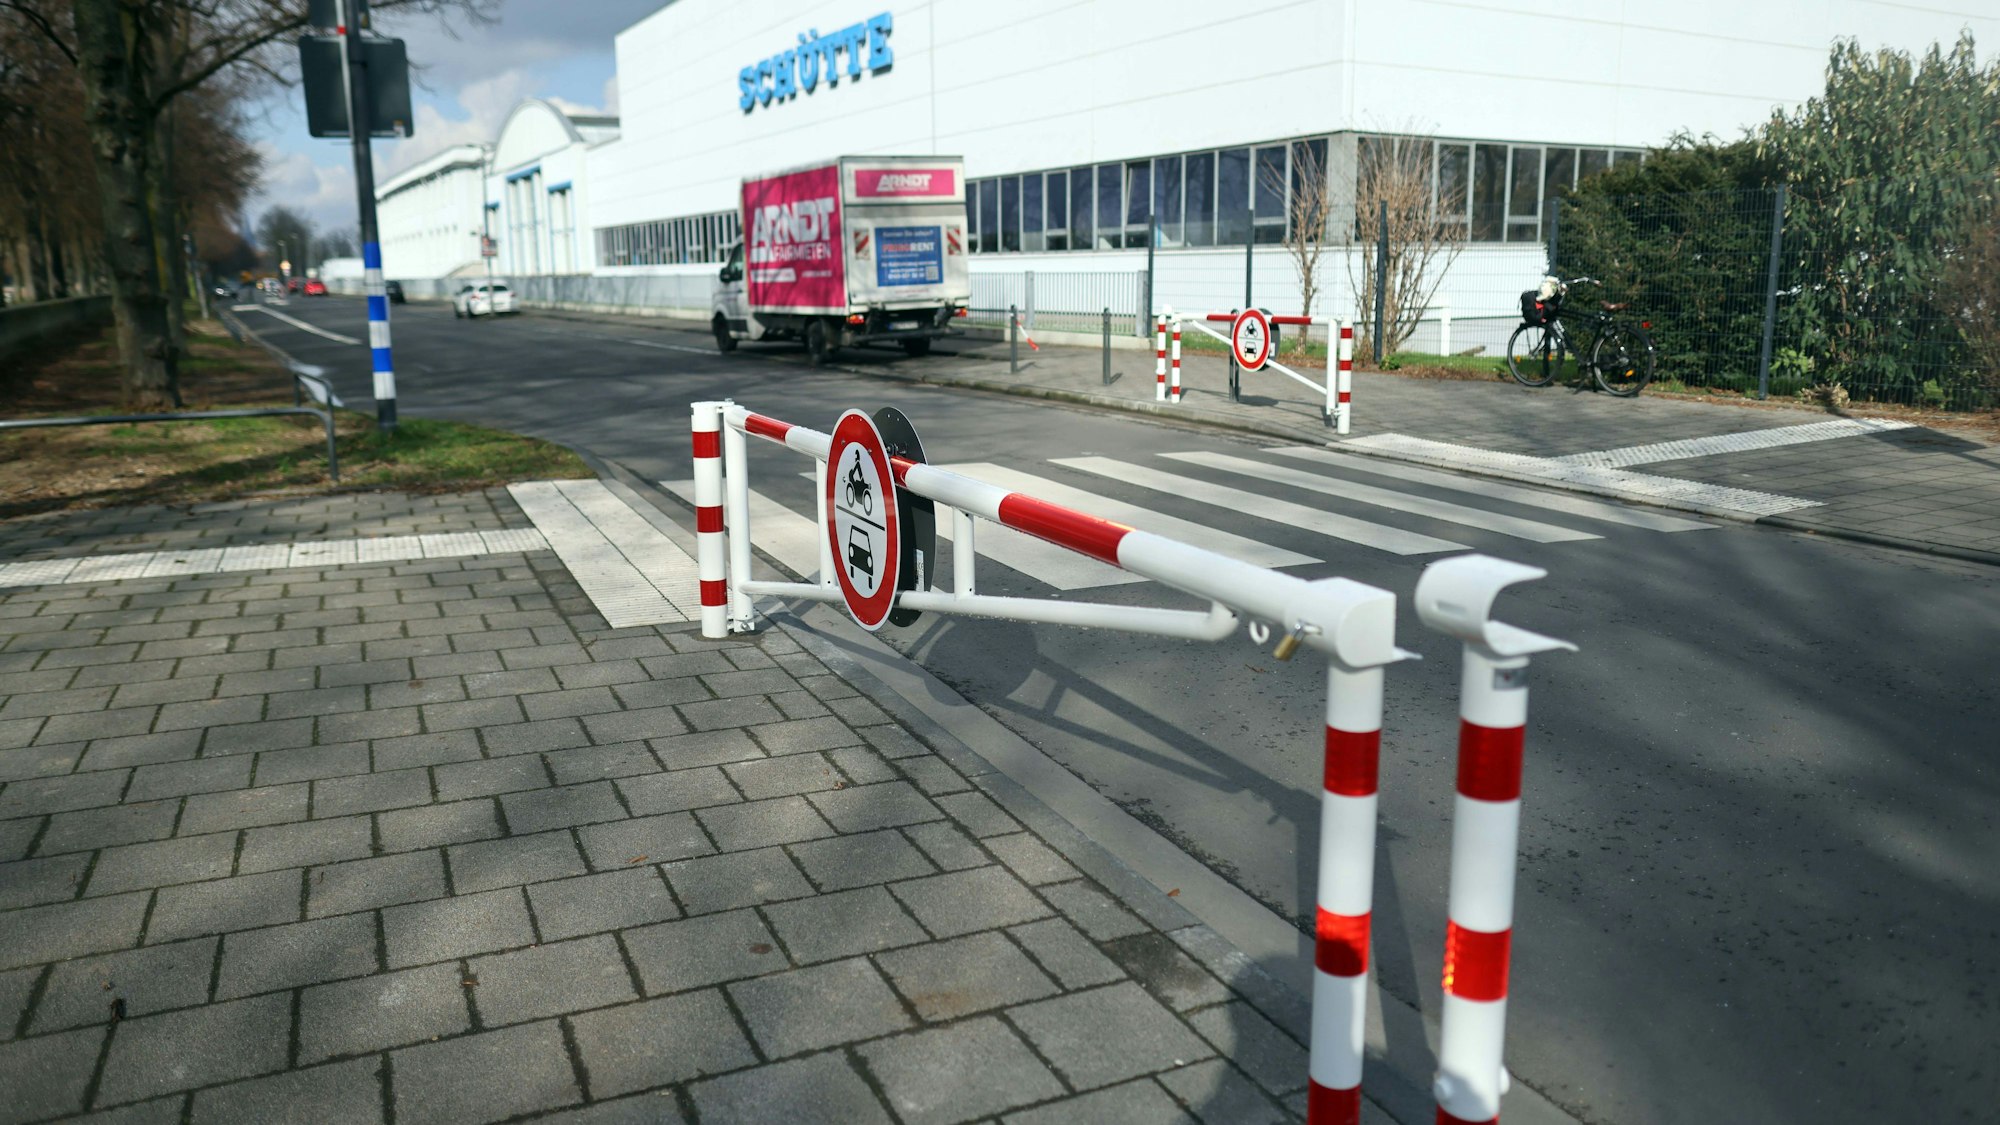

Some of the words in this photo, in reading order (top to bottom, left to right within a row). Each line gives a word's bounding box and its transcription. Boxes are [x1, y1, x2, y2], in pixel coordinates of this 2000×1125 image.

[738, 11, 893, 113] SCHÜTTE
[876, 173, 932, 192] ARNDT
[751, 197, 834, 263] ARNDT
